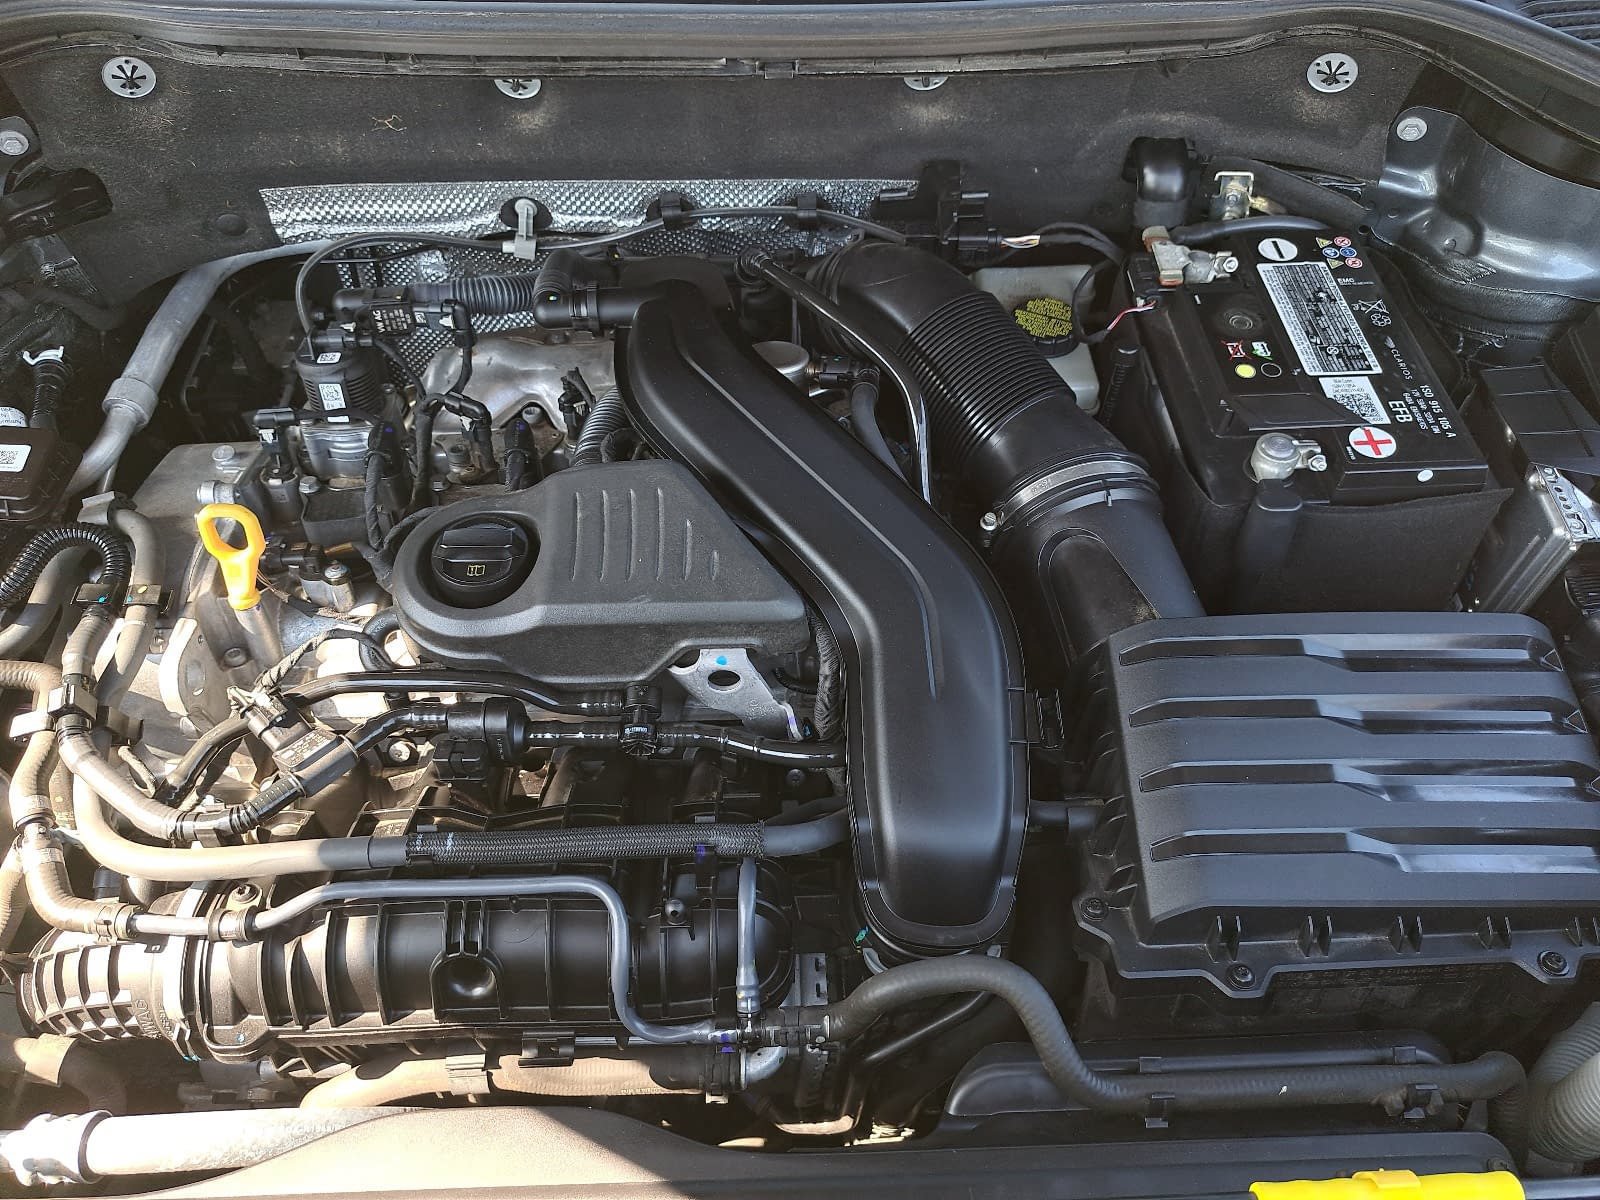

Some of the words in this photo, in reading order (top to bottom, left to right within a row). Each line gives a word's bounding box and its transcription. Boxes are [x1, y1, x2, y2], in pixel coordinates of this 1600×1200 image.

[373, 310, 382, 320] AG
[1391, 349, 1413, 380] CLARIOS
[1388, 400, 1413, 423] EFB
[1428, 400, 1443, 413] 915
[1438, 417, 1452, 430] 105
